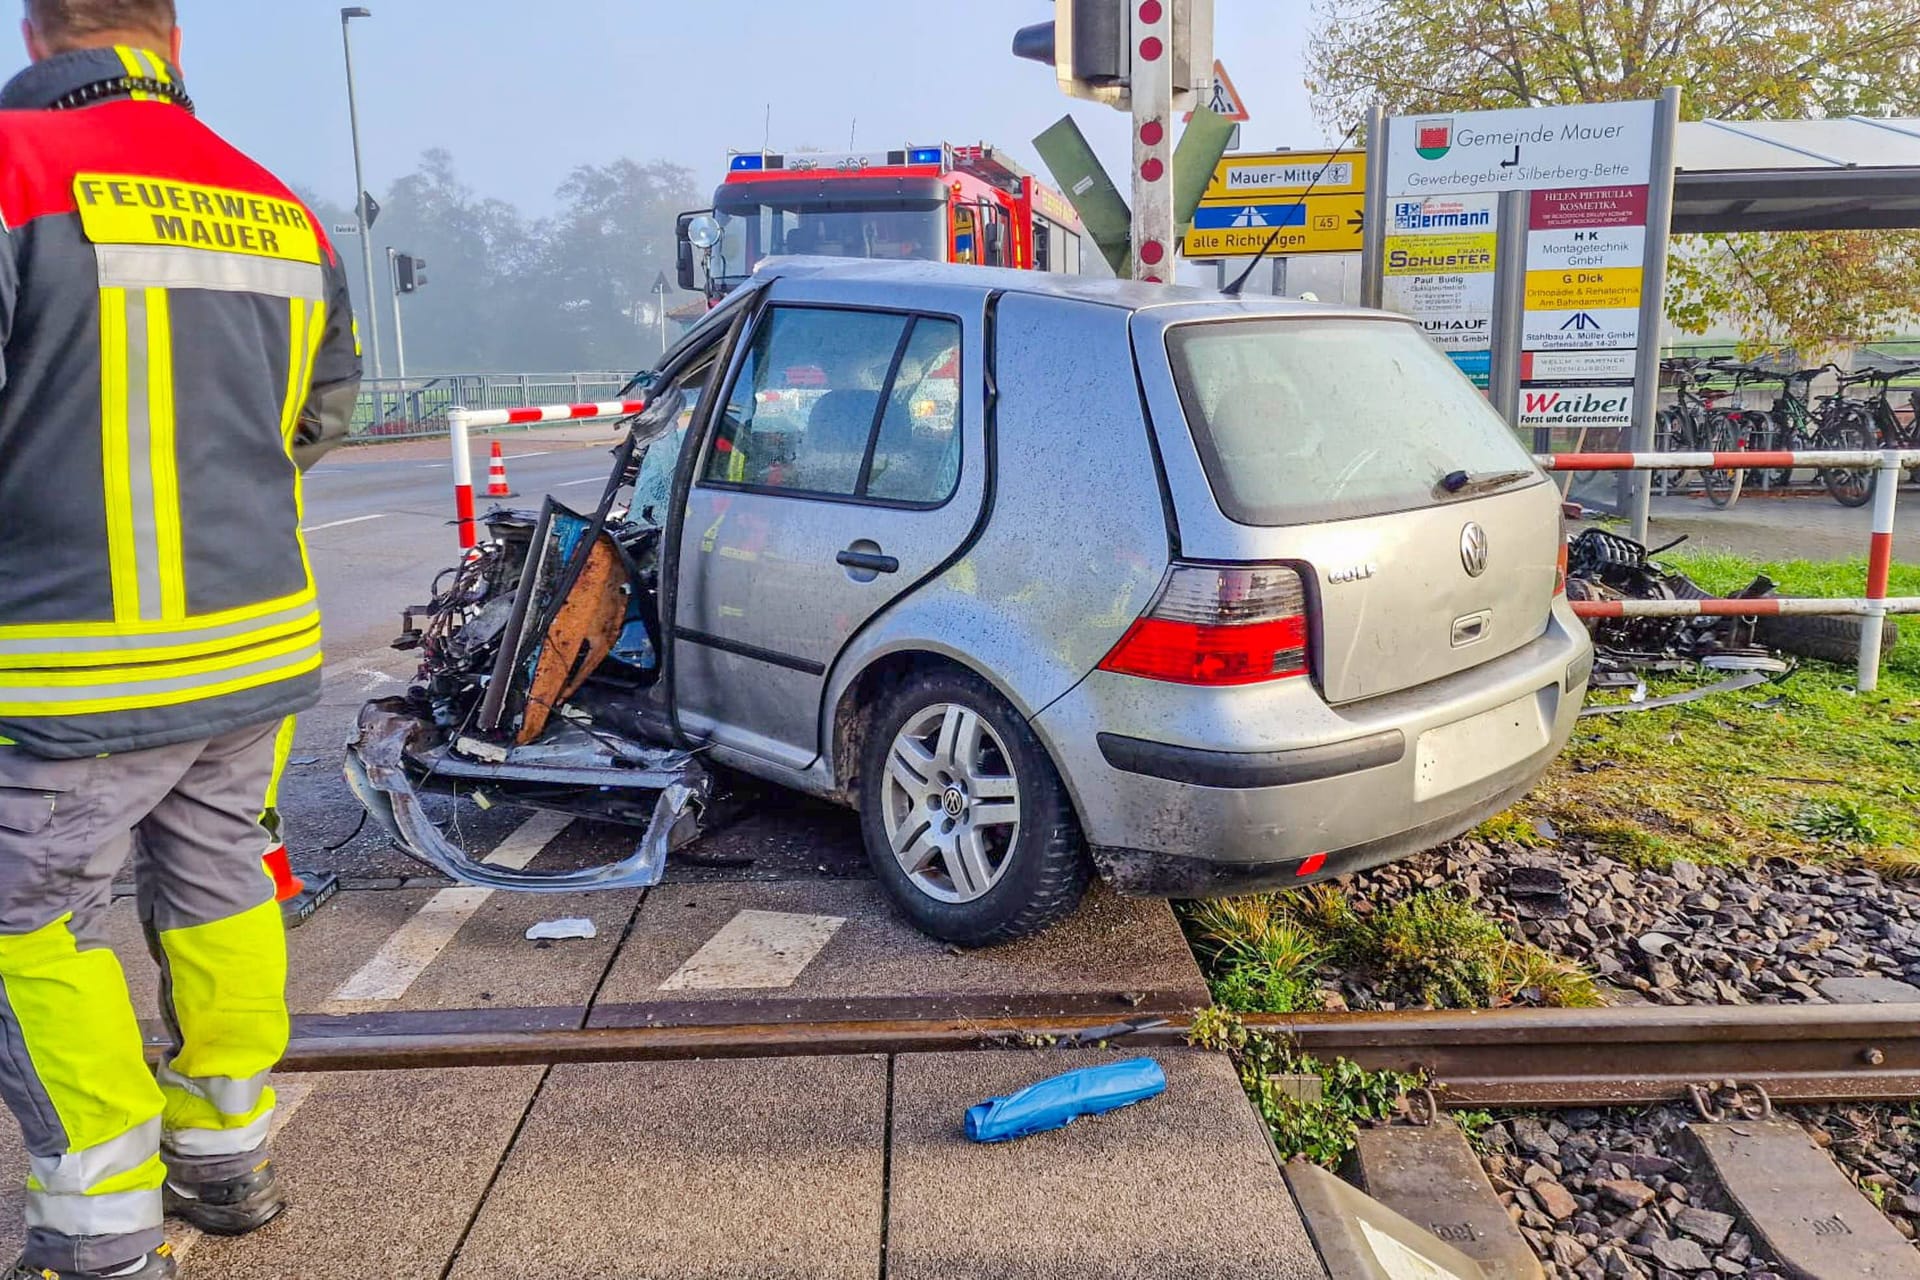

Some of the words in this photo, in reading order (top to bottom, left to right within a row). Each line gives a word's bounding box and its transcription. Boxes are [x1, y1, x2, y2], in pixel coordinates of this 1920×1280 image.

[1457, 124, 1553, 148] Gemeinde
[1560, 124, 1624, 141] Mauer
[1230, 169, 1321, 184] Mauer-Mitte
[1407, 170, 1513, 188] Gewerbegebiet
[1517, 163, 1630, 181] Silberberg-Bette
[1544, 191, 1578, 201] HELEN
[1580, 190, 1633, 200] PIETRULLA
[79, 180, 309, 231] FEUERWEHR
[1560, 201, 1617, 211] KOSMETIKA
[1319, 217, 1333, 228] 45
[1408, 212, 1489, 228] Herrmann
[150, 213, 281, 253] MAUER
[1574, 232, 1584, 241] H
[1589, 231, 1599, 241] K
[1193, 234, 1219, 248] alle
[1225, 233, 1306, 249] Richtungen
[1542, 242, 1630, 255] Montagetechnik
[1389, 250, 1490, 268] SCHUSTER
[1568, 256, 1603, 266] GmbH
[1414, 276, 1433, 285] Paul
[1578, 273, 1604, 284] Dick
[1539, 299, 1554, 307] Am
[1557, 297, 1606, 307] Bahndamm
[1462, 334, 1489, 343] GmbH
[1526, 332, 1564, 341] Stahlbau
[1579, 331, 1604, 340] Müller
[1607, 330, 1635, 340] GmbH
[1525, 391, 1628, 414] Waibel
[1520, 414, 1544, 424] Forst
[1546, 414, 1563, 423] und
[1566, 414, 1630, 424] Gartenservice
